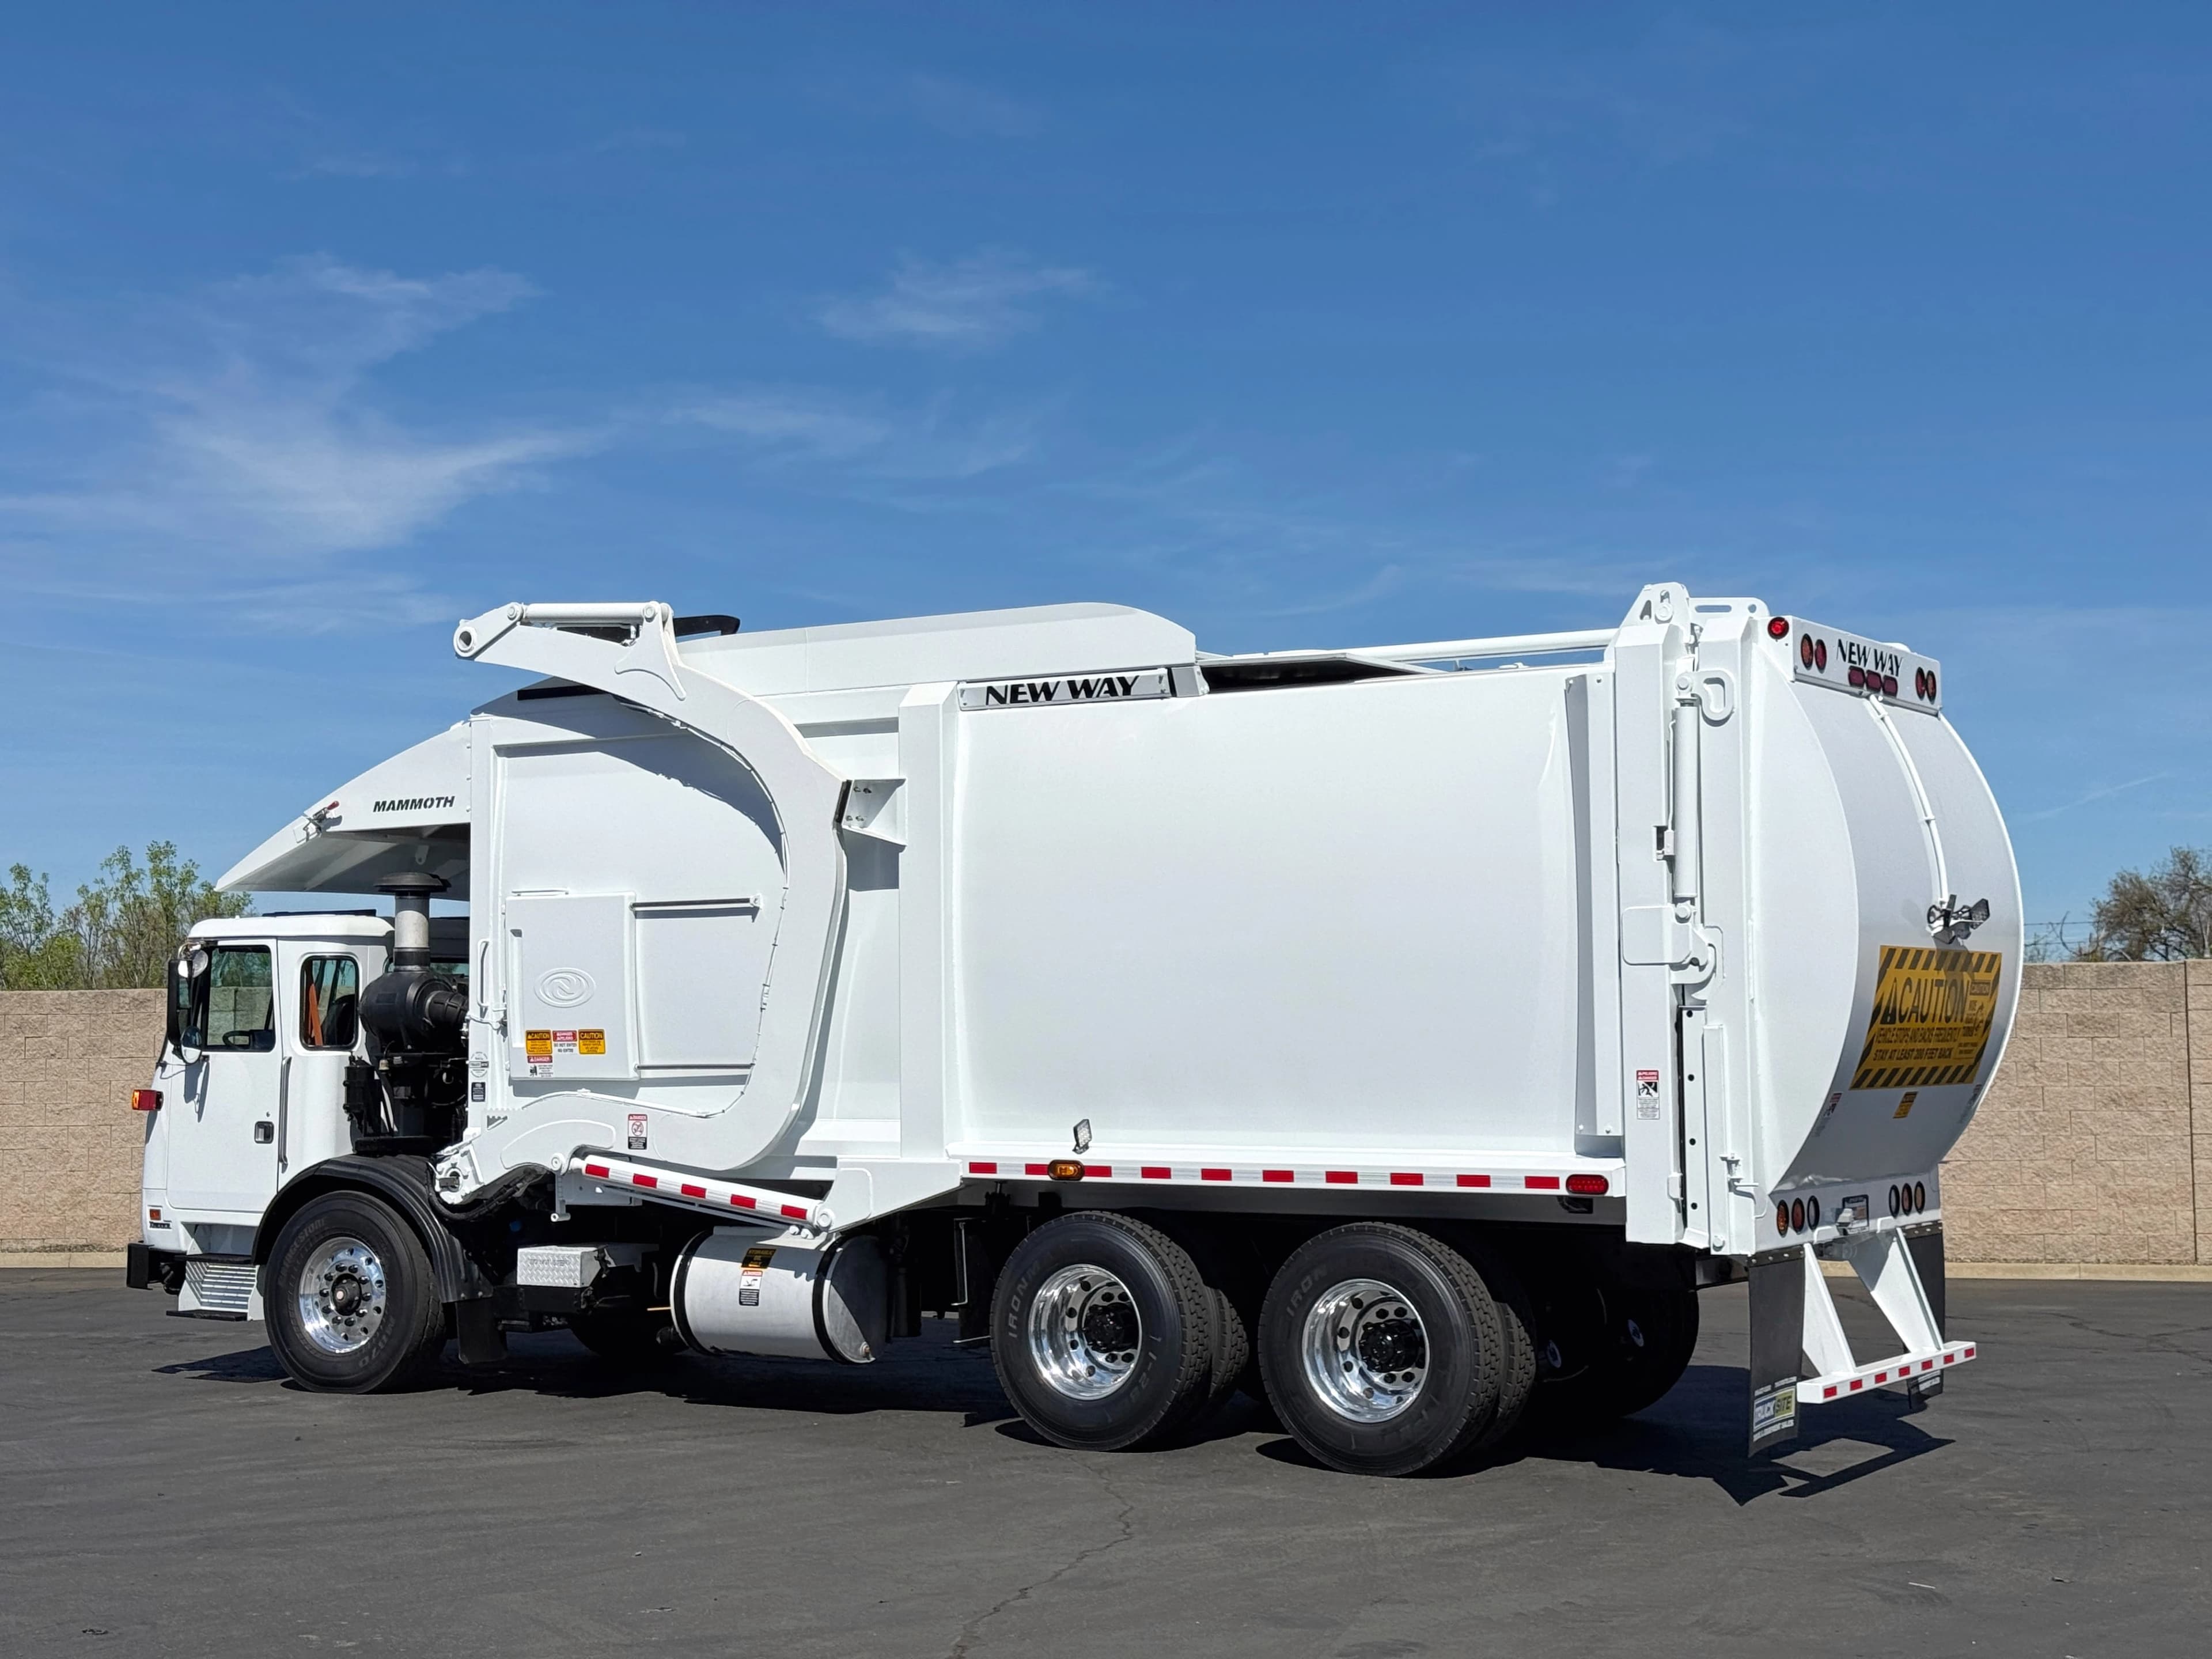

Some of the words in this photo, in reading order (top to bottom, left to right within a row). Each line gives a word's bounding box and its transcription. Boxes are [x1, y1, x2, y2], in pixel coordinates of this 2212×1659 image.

[1836, 638, 1871, 668] NEW
[1873, 648, 1904, 677] WAY
[985, 680, 1060, 706] NEW
[1067, 675, 1140, 700] WAY
[373, 795, 456, 813] MAMMOTH
[1898, 977, 1970, 1024] CAUTION
[1873, 1050, 1891, 1061] STAY
[1895, 1049, 1915, 1060] LEAST
[1923, 1048, 1940, 1059] FEET
[1937, 1048, 1953, 1059] BACK
[1775, 1395, 1794, 1415] SITE
